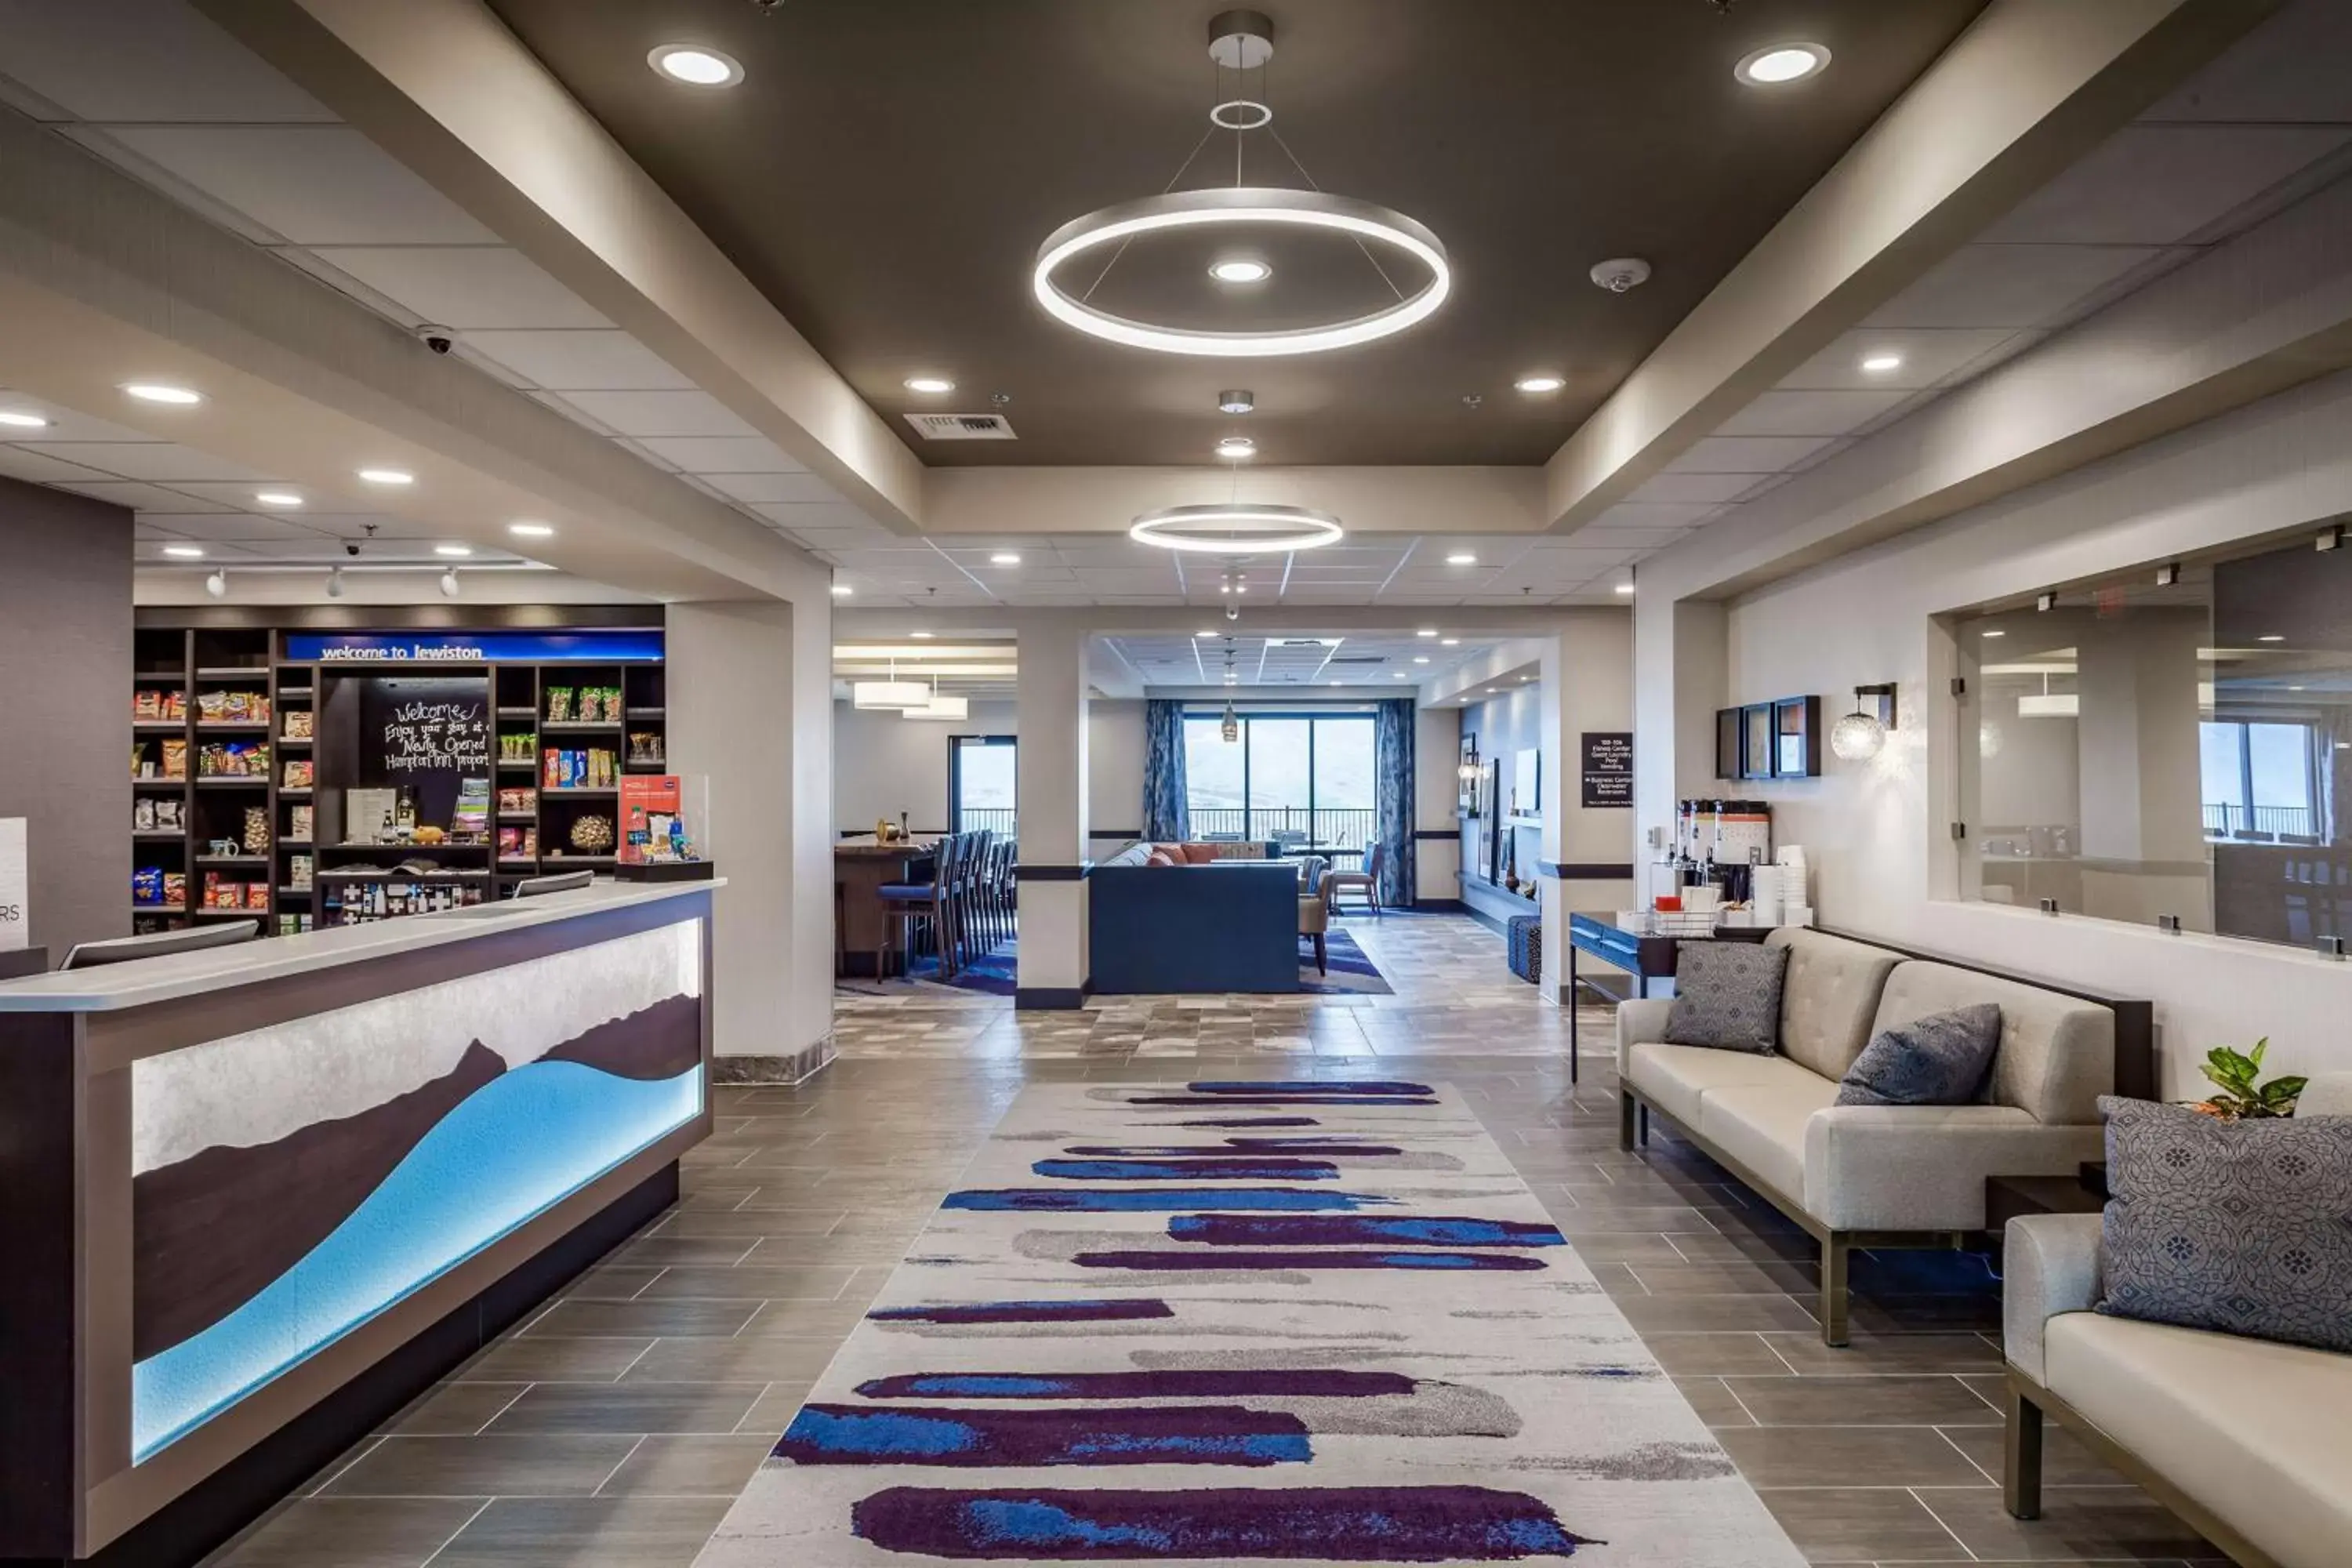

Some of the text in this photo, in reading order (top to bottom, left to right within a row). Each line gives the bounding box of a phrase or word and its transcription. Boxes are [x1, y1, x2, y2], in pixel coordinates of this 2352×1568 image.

[322, 644, 482, 659] welcome to lewiston
[395, 702, 477, 722] Welcome
[385, 724, 416, 742] Enjoy
[403, 735, 486, 757] Newly Opened
[386, 752, 432, 772] Hampton
